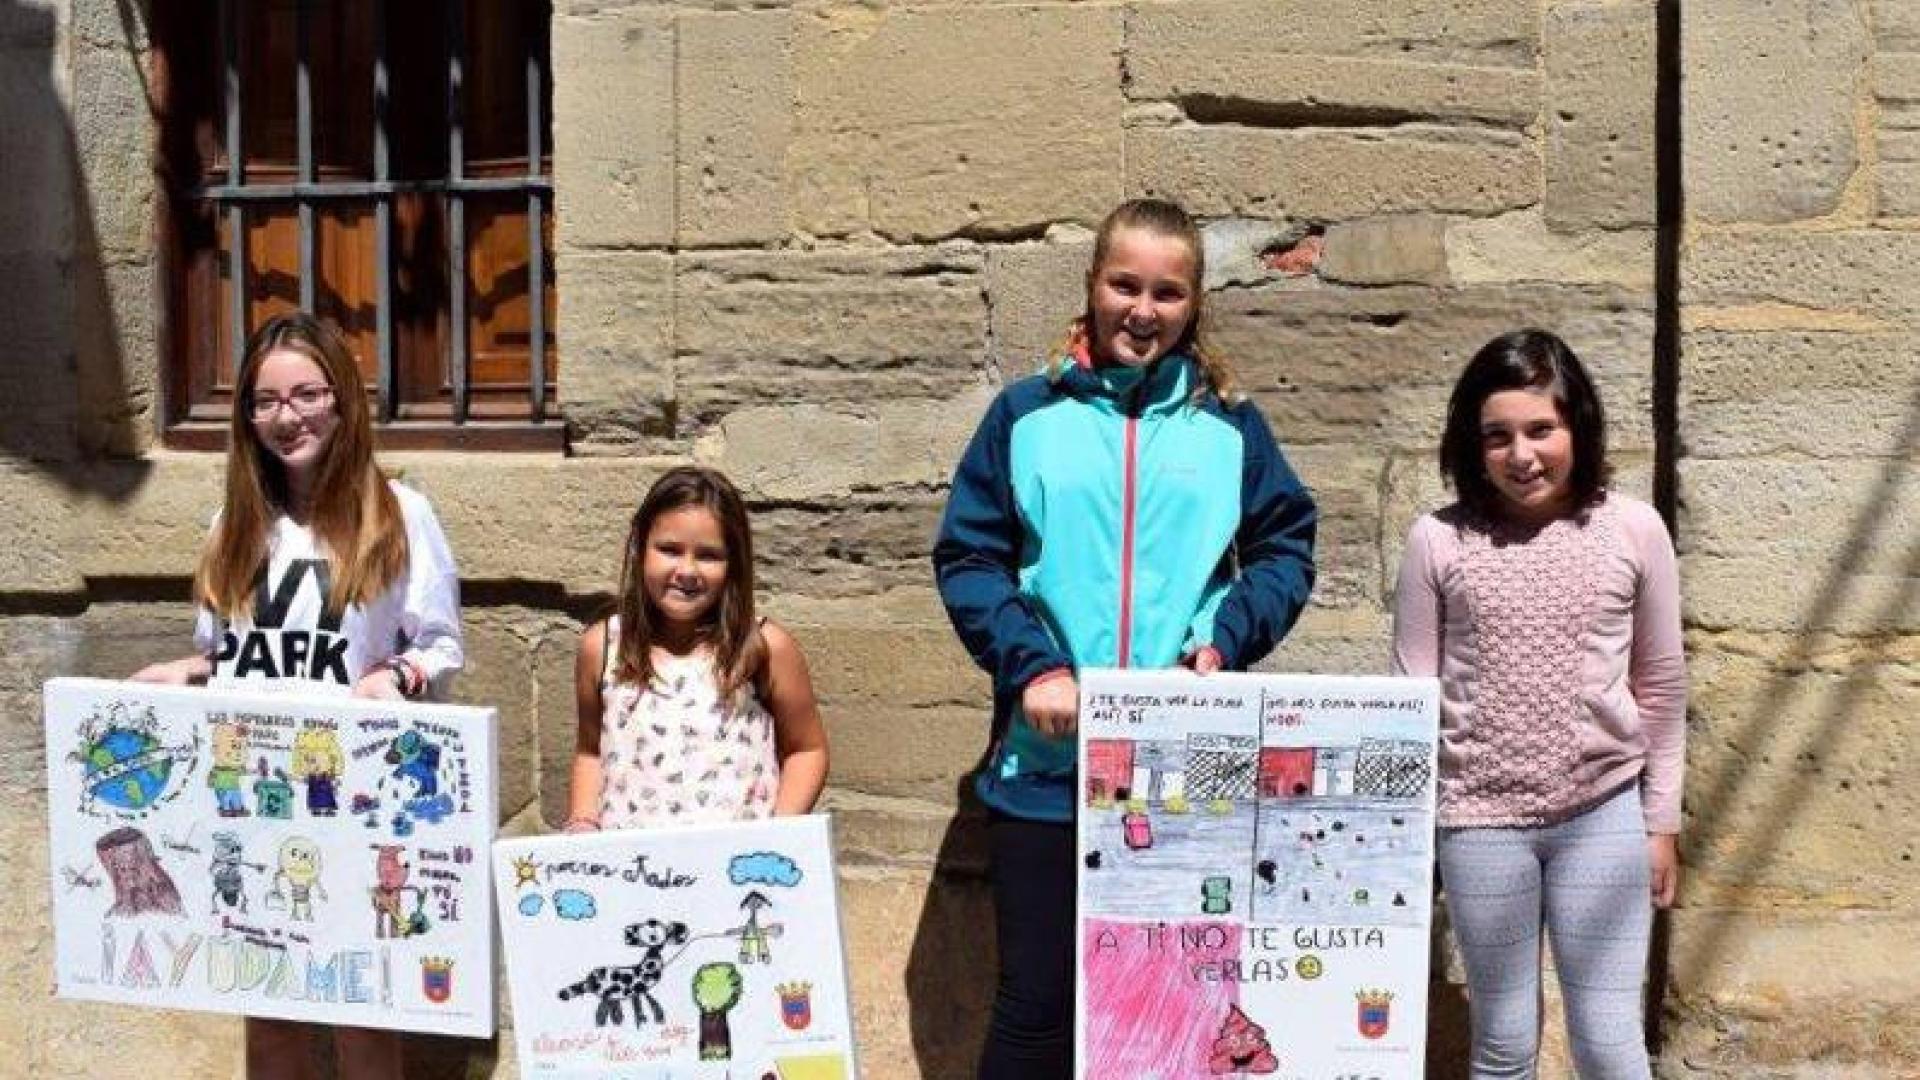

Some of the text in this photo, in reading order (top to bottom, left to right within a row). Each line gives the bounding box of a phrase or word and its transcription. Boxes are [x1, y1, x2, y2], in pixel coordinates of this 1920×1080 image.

[1096, 927, 1120, 953] A
[1181, 924, 1229, 950] NO
[1247, 926, 1279, 950] TE
[1293, 926, 1385, 950] GUSTA
[1191, 957, 1290, 983] VERLAS
